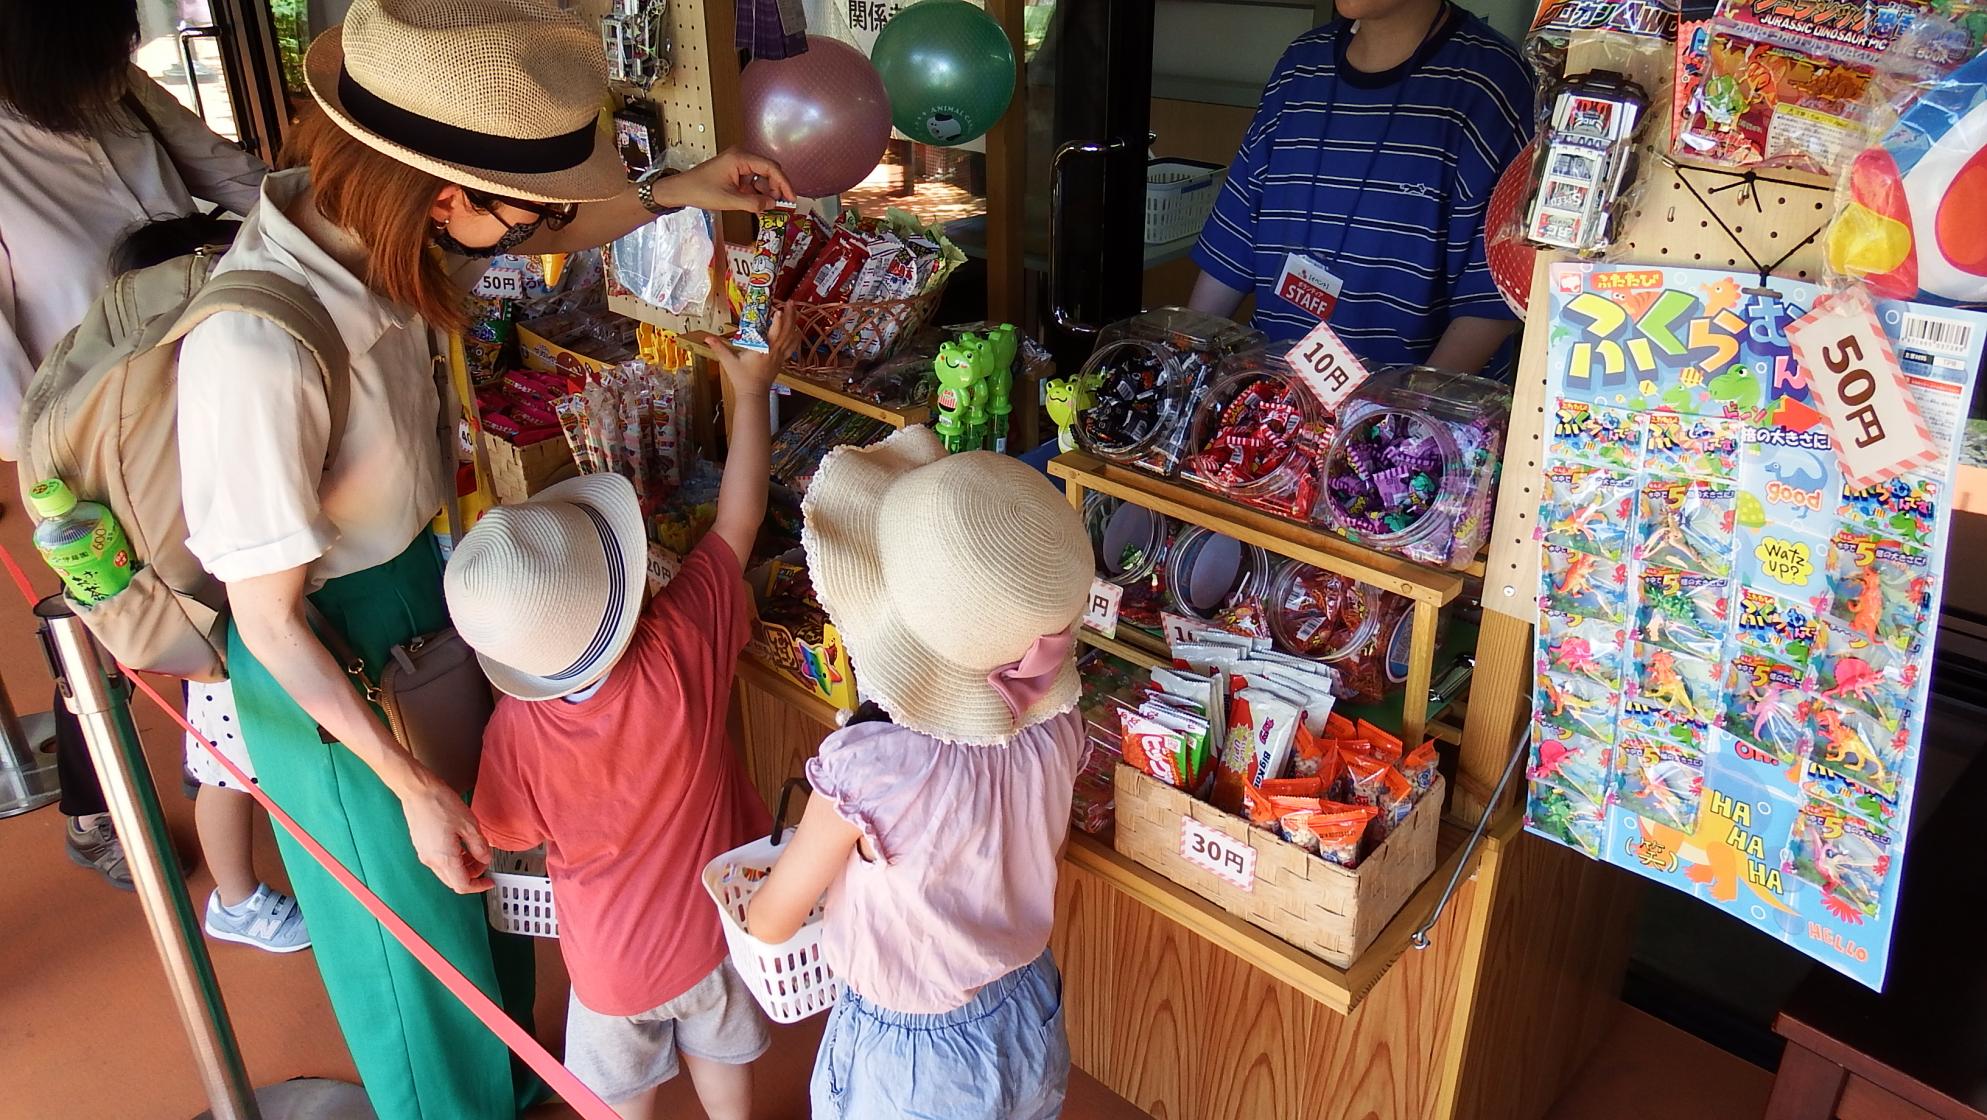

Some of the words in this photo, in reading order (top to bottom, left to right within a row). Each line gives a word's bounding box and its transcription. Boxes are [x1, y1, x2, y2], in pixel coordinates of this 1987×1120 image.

[1760, 14, 1813, 36] JURASSIC
[1814, 25, 1868, 47] DINOSAUR
[483, 276, 515, 290] 50円
[733, 257, 750, 277] 10
[1597, 272, 1660, 289] ふたたび
[1285, 284, 1328, 315] STAFF
[1303, 341, 1350, 393] 10円
[1822, 334, 1886, 449] 50円
[1766, 480, 1823, 512] good
[1091, 594, 1109, 618] 円
[1710, 790, 1751, 828] HA
[1191, 832, 1244, 875] 30円
[1624, 835, 1679, 874] (笑)
[1726, 825, 1766, 861] HA
[1747, 859, 1785, 896] HA
[1807, 920, 1869, 964] HELLO
